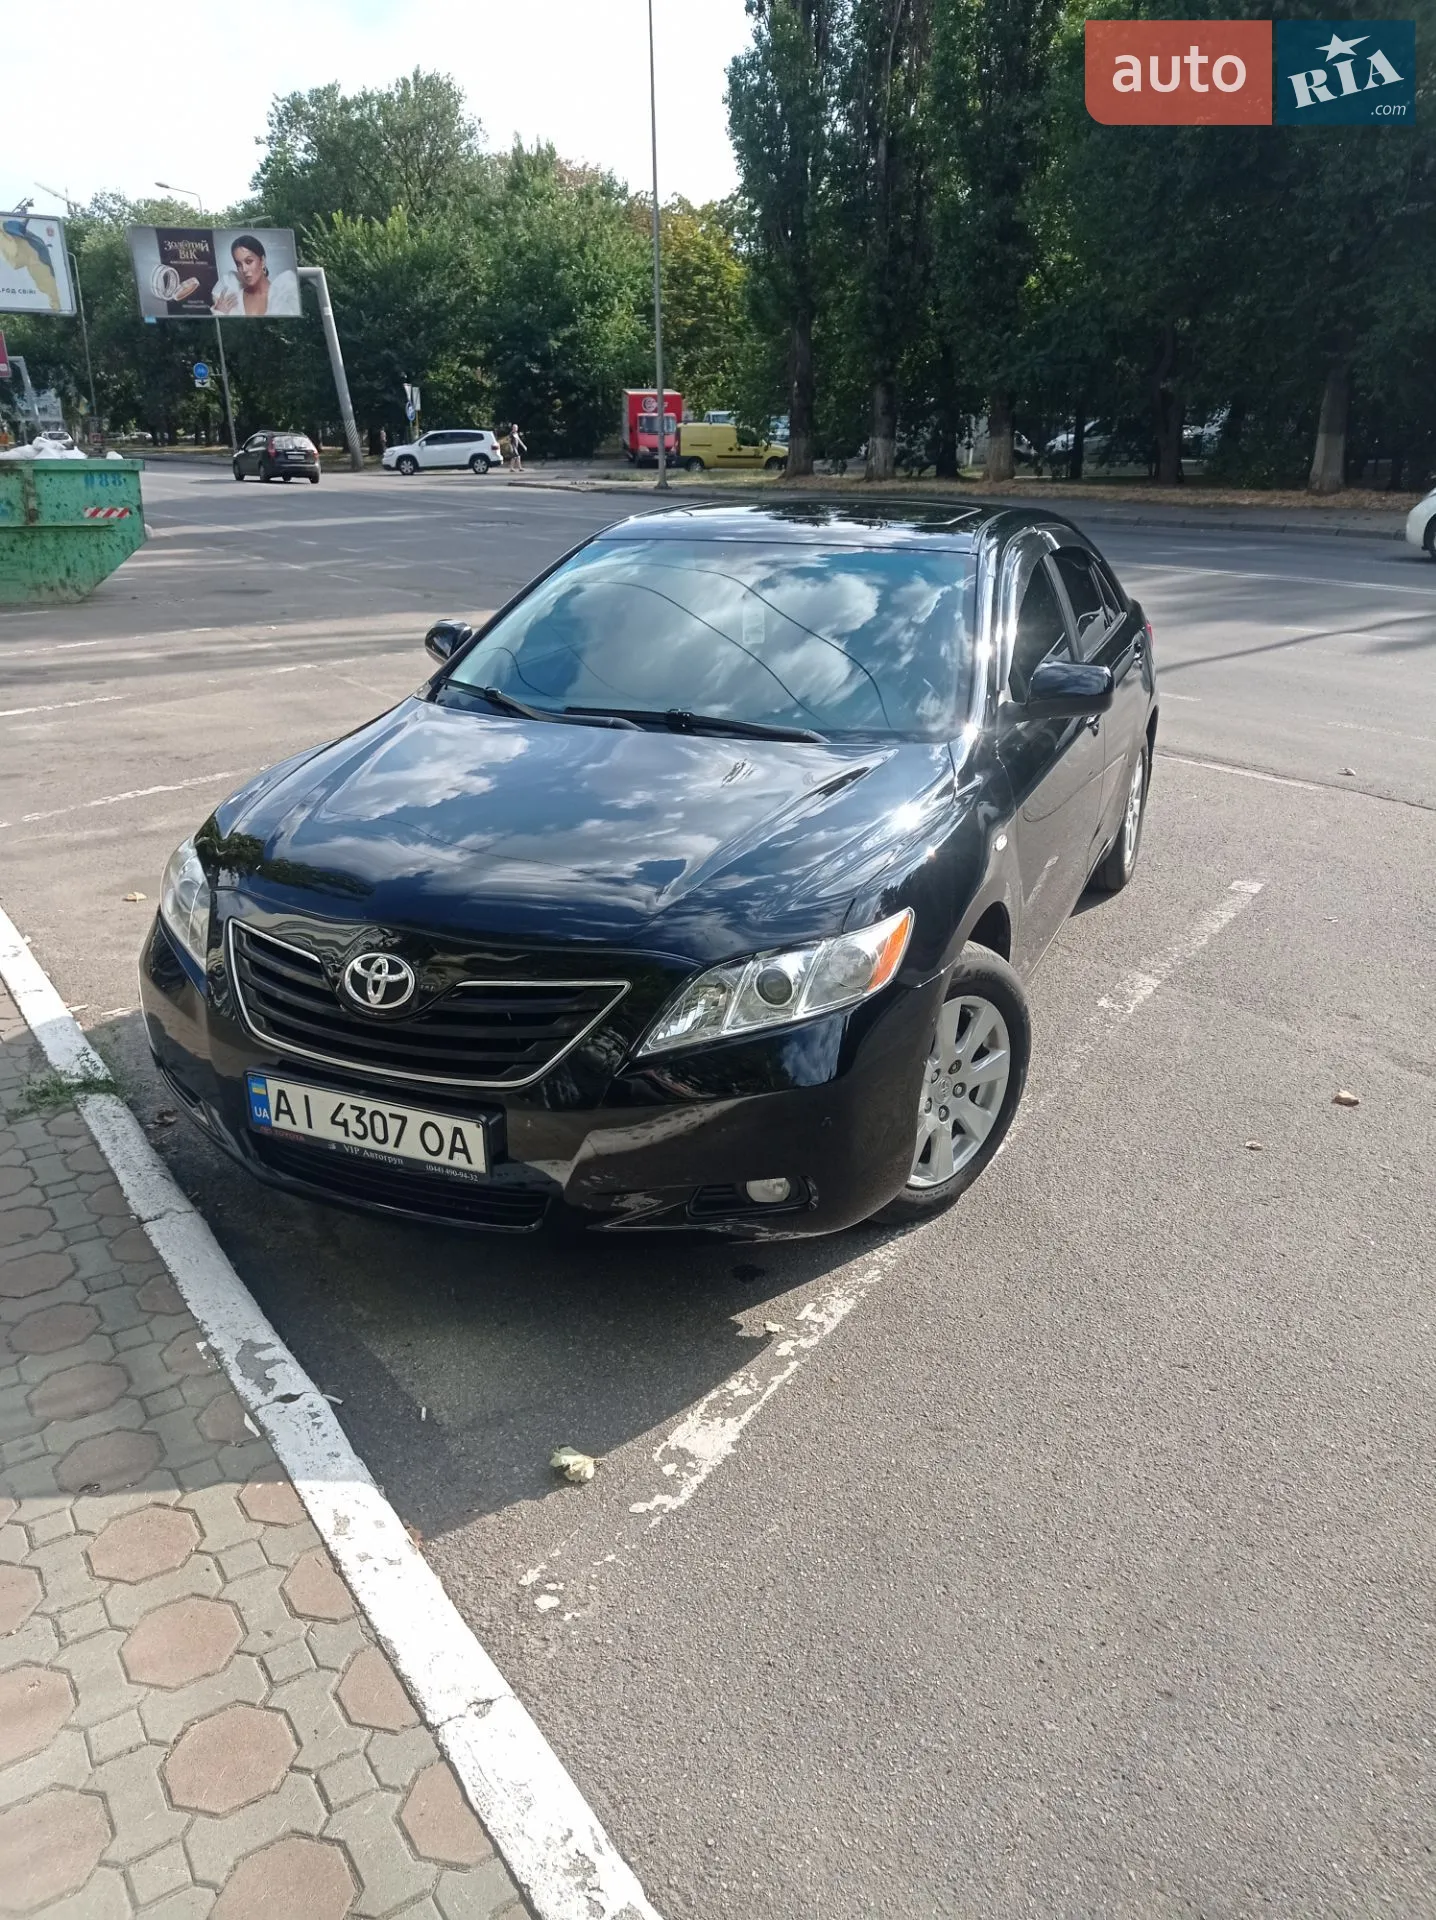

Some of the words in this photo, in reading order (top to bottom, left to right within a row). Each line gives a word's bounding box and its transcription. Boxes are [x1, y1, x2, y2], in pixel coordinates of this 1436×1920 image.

[254, 1105, 270, 1120] UA
[274, 1089, 313, 1129] AI
[330, 1102, 408, 1148] 4307
[419, 1121, 473, 1165] OA
